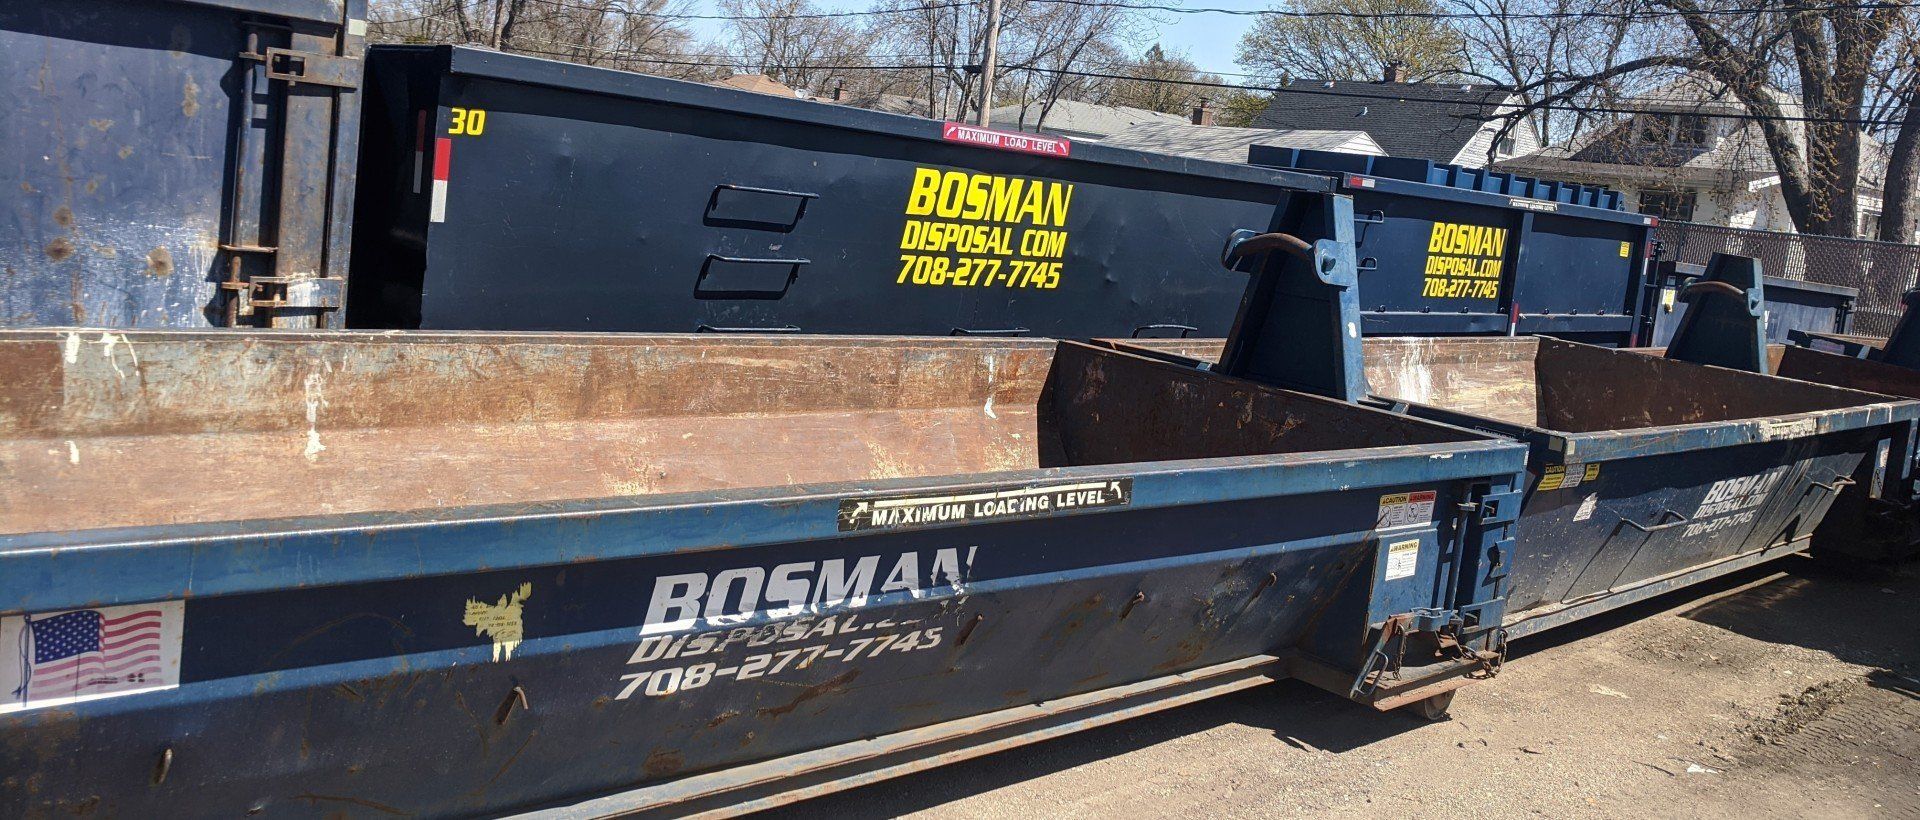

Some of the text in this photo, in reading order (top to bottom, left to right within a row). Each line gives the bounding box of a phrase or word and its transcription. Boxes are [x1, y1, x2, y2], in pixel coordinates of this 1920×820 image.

[448, 107, 486, 136] 30
[957, 129, 1058, 153] MAXIMUM LOAD LEVEL
[905, 167, 1074, 227] BOSMAN
[900, 220, 1068, 258] DISPOSAL COM
[1428, 222, 1507, 257] BOSMAN
[896, 254, 1064, 289] 708-277-7745
[1424, 255, 1502, 278] DISPOSAL.COM
[1422, 277, 1499, 299] 708-277-7745
[871, 504, 966, 526] MAXIMUM
[1056, 490, 1106, 508] LEVEL
[1385, 495, 1407, 505] CAUTION
[1392, 541, 1418, 552] WARNING
[639, 546, 978, 636] BOSMAN
[614, 627, 943, 700] 708-277-7745
